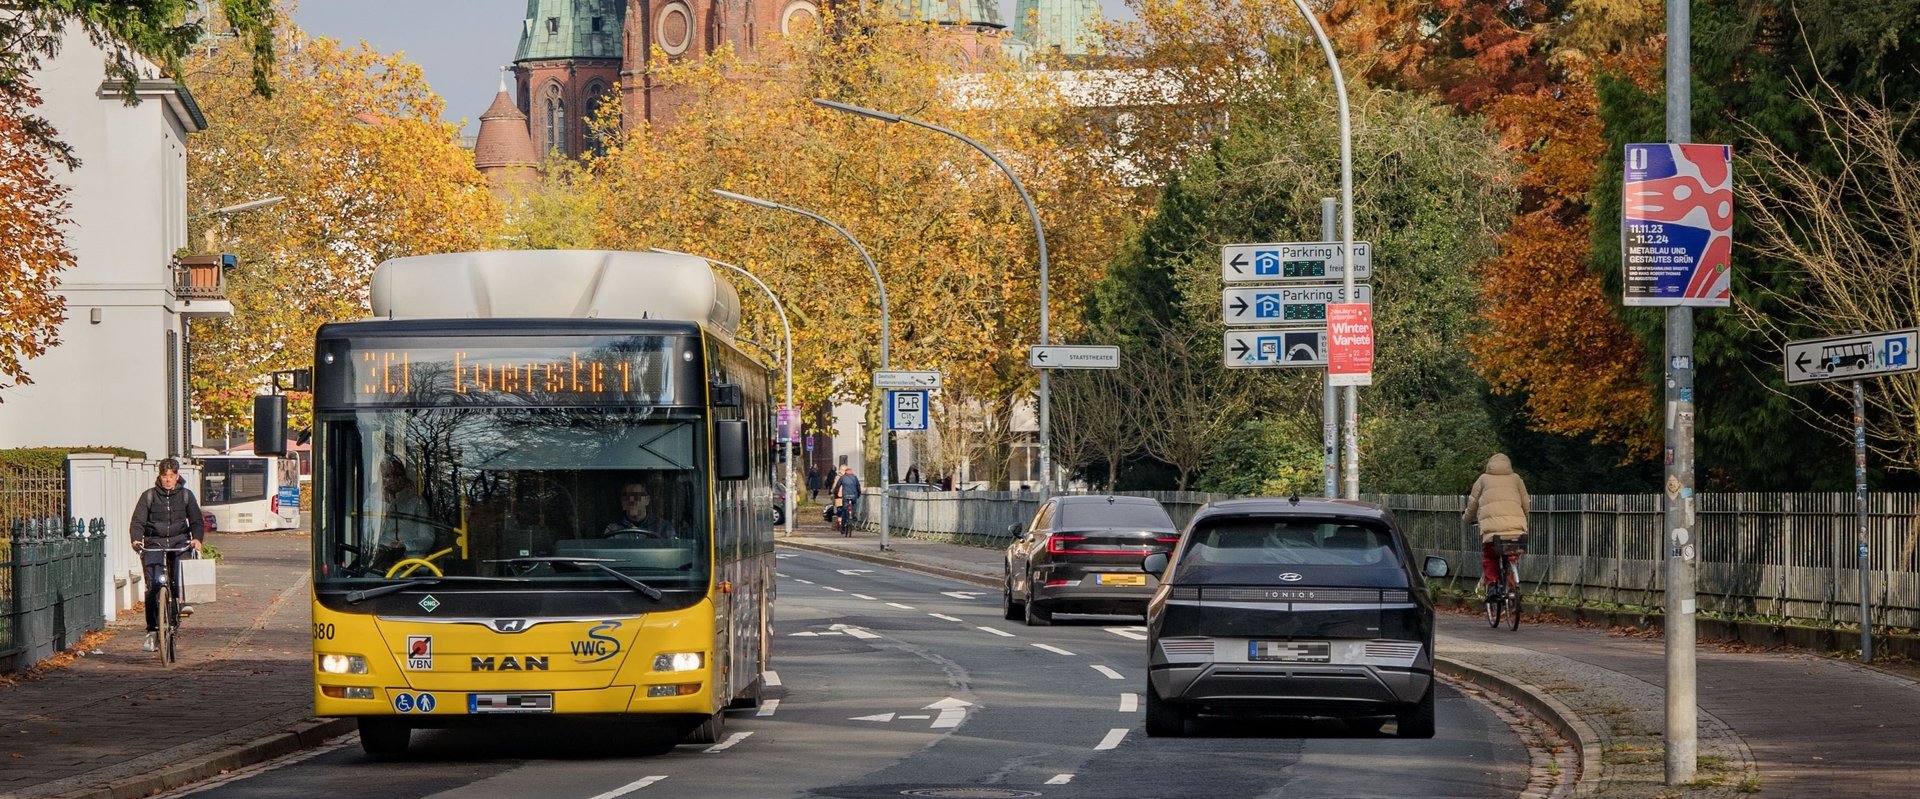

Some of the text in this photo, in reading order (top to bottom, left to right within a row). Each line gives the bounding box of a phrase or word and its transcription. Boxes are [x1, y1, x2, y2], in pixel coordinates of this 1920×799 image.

[1630, 224, 1663, 234] 11.11.23
[1282, 245, 1365, 259] Parkring Nrd
[1673, 254, 1694, 264] GRÜN
[1262, 260, 1274, 274] P
[1283, 288, 1360, 302] Parkring Sd
[1332, 322, 1369, 334] Winter
[1333, 334, 1371, 346] Varieté
[1888, 340, 1903, 364] P
[898, 396, 920, 409] P+R
[901, 412, 915, 421] City
[570, 640, 606, 656] VWG
[408, 660, 432, 669] VBN
[471, 656, 549, 672] MAN
